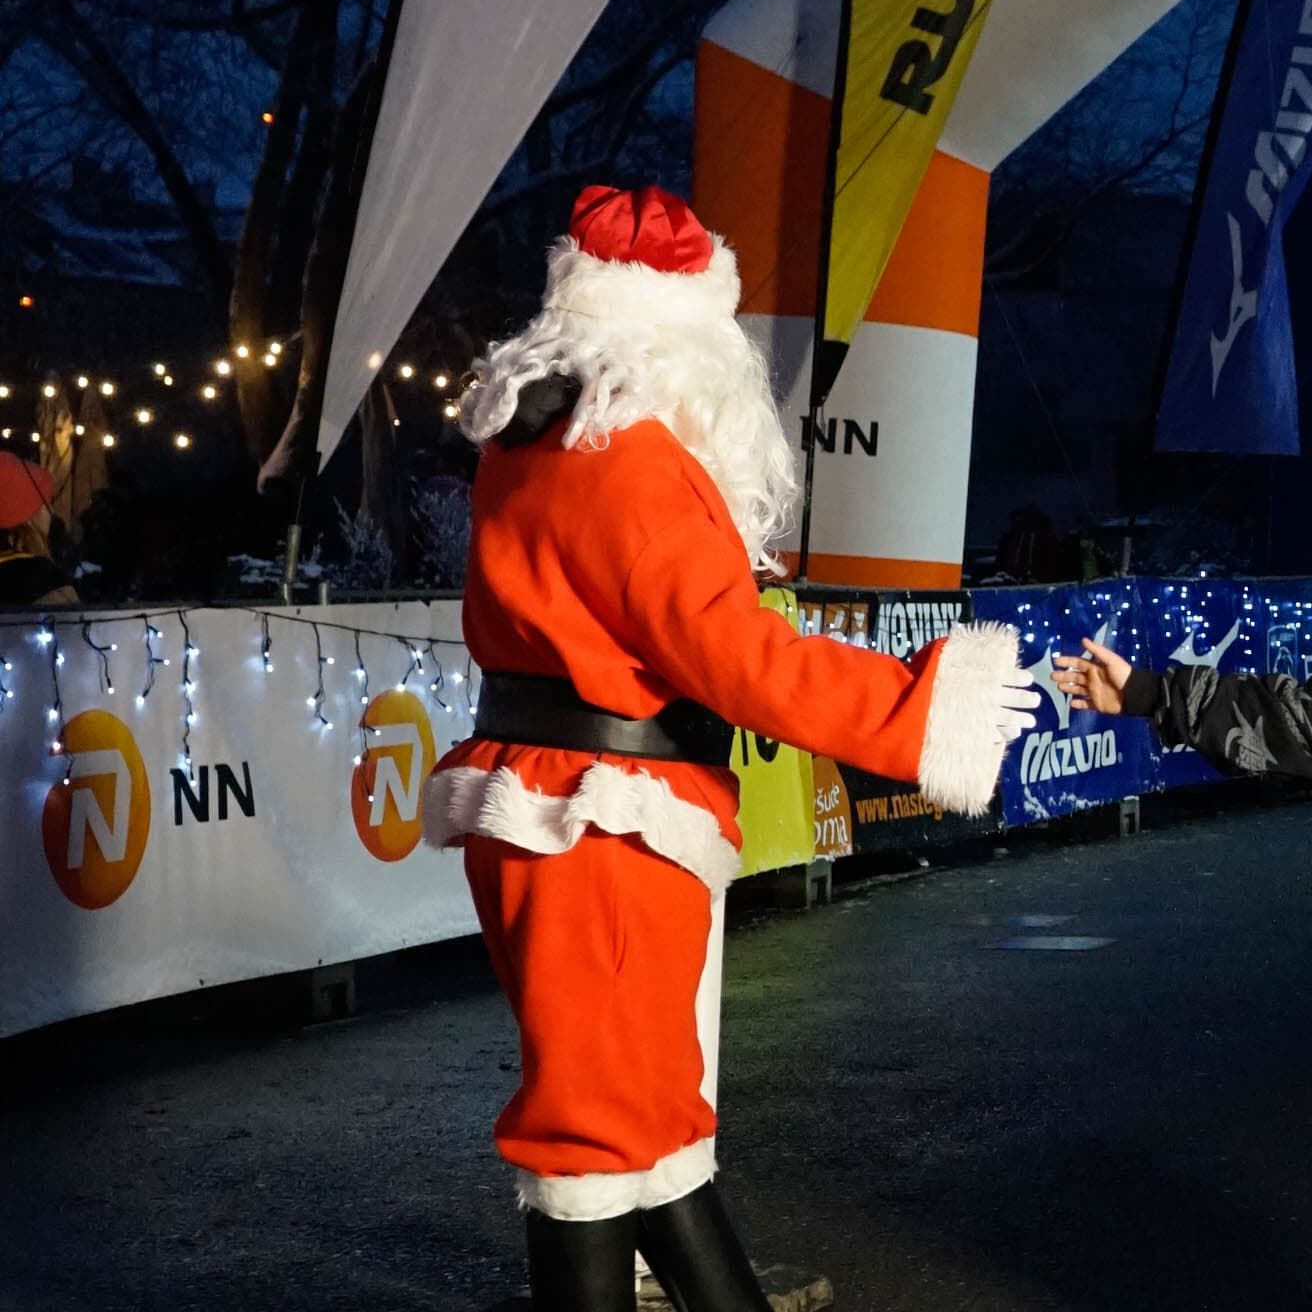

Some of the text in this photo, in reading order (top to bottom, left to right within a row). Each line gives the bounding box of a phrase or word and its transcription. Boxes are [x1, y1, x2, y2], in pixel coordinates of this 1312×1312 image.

[800, 416, 878, 456] NN
[1021, 728, 1117, 784] MIZUNO
[170, 762, 256, 825] NN
